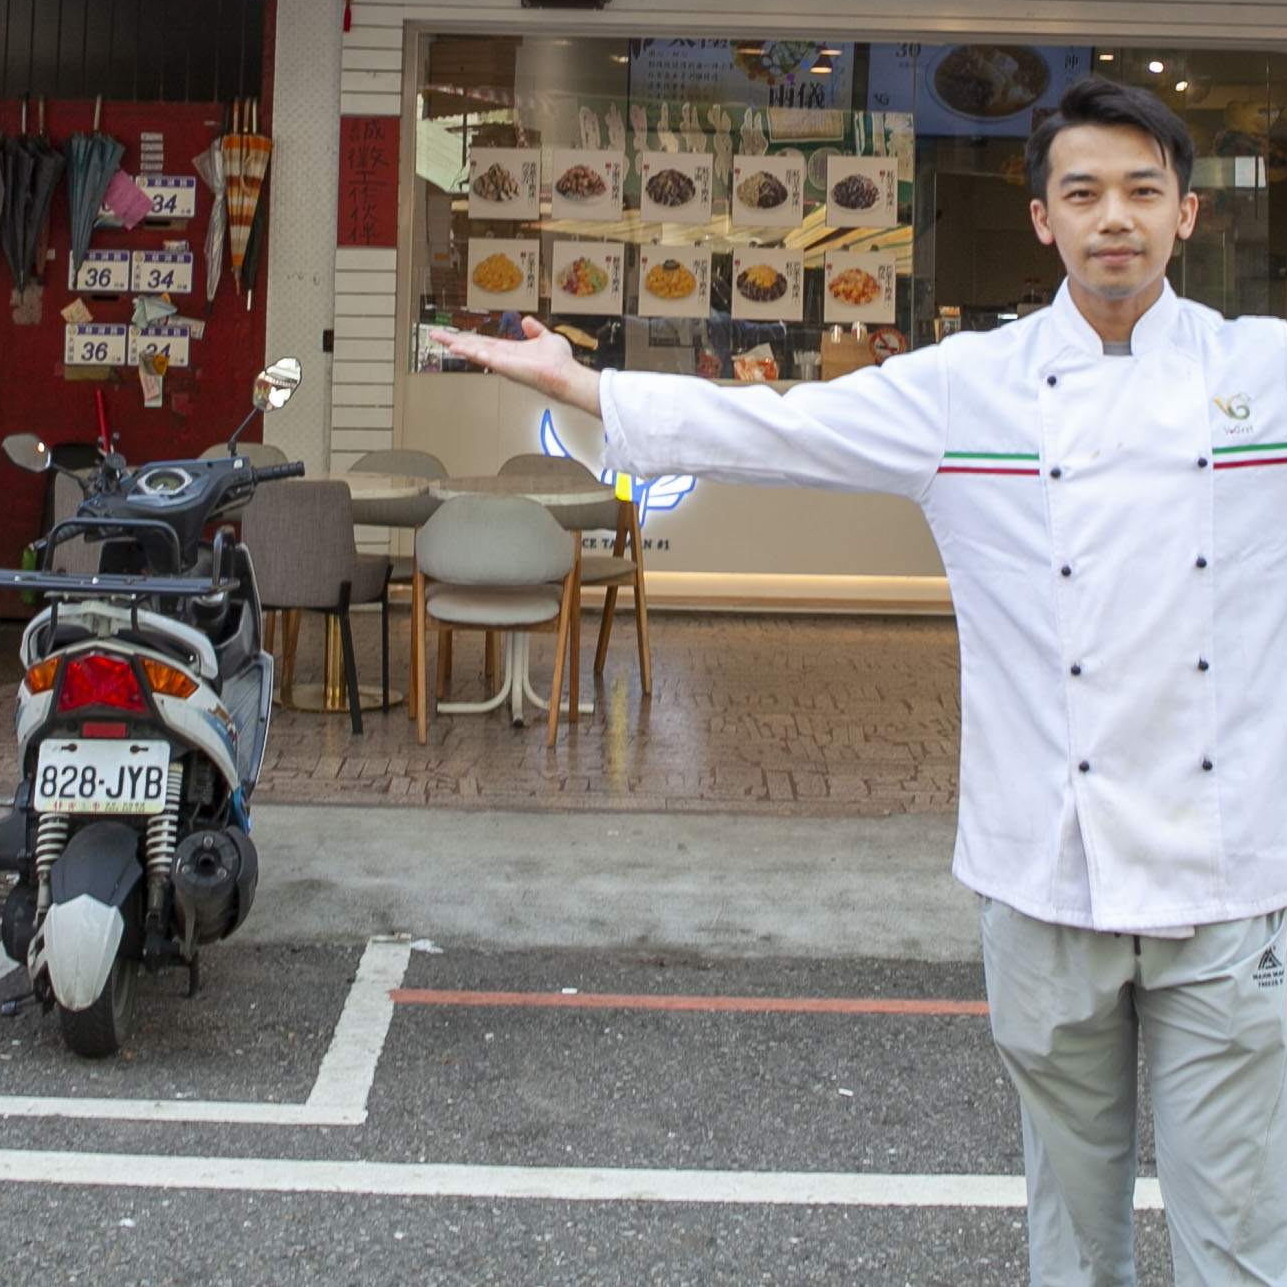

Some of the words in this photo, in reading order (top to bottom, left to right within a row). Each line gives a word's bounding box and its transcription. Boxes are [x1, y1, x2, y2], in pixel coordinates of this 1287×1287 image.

[152, 193, 178, 214] 34
[84, 267, 112, 288] 36
[147, 269, 175, 289] 34
[80, 341, 108, 362] 36
[40, 765, 163, 800] 828-JYB
